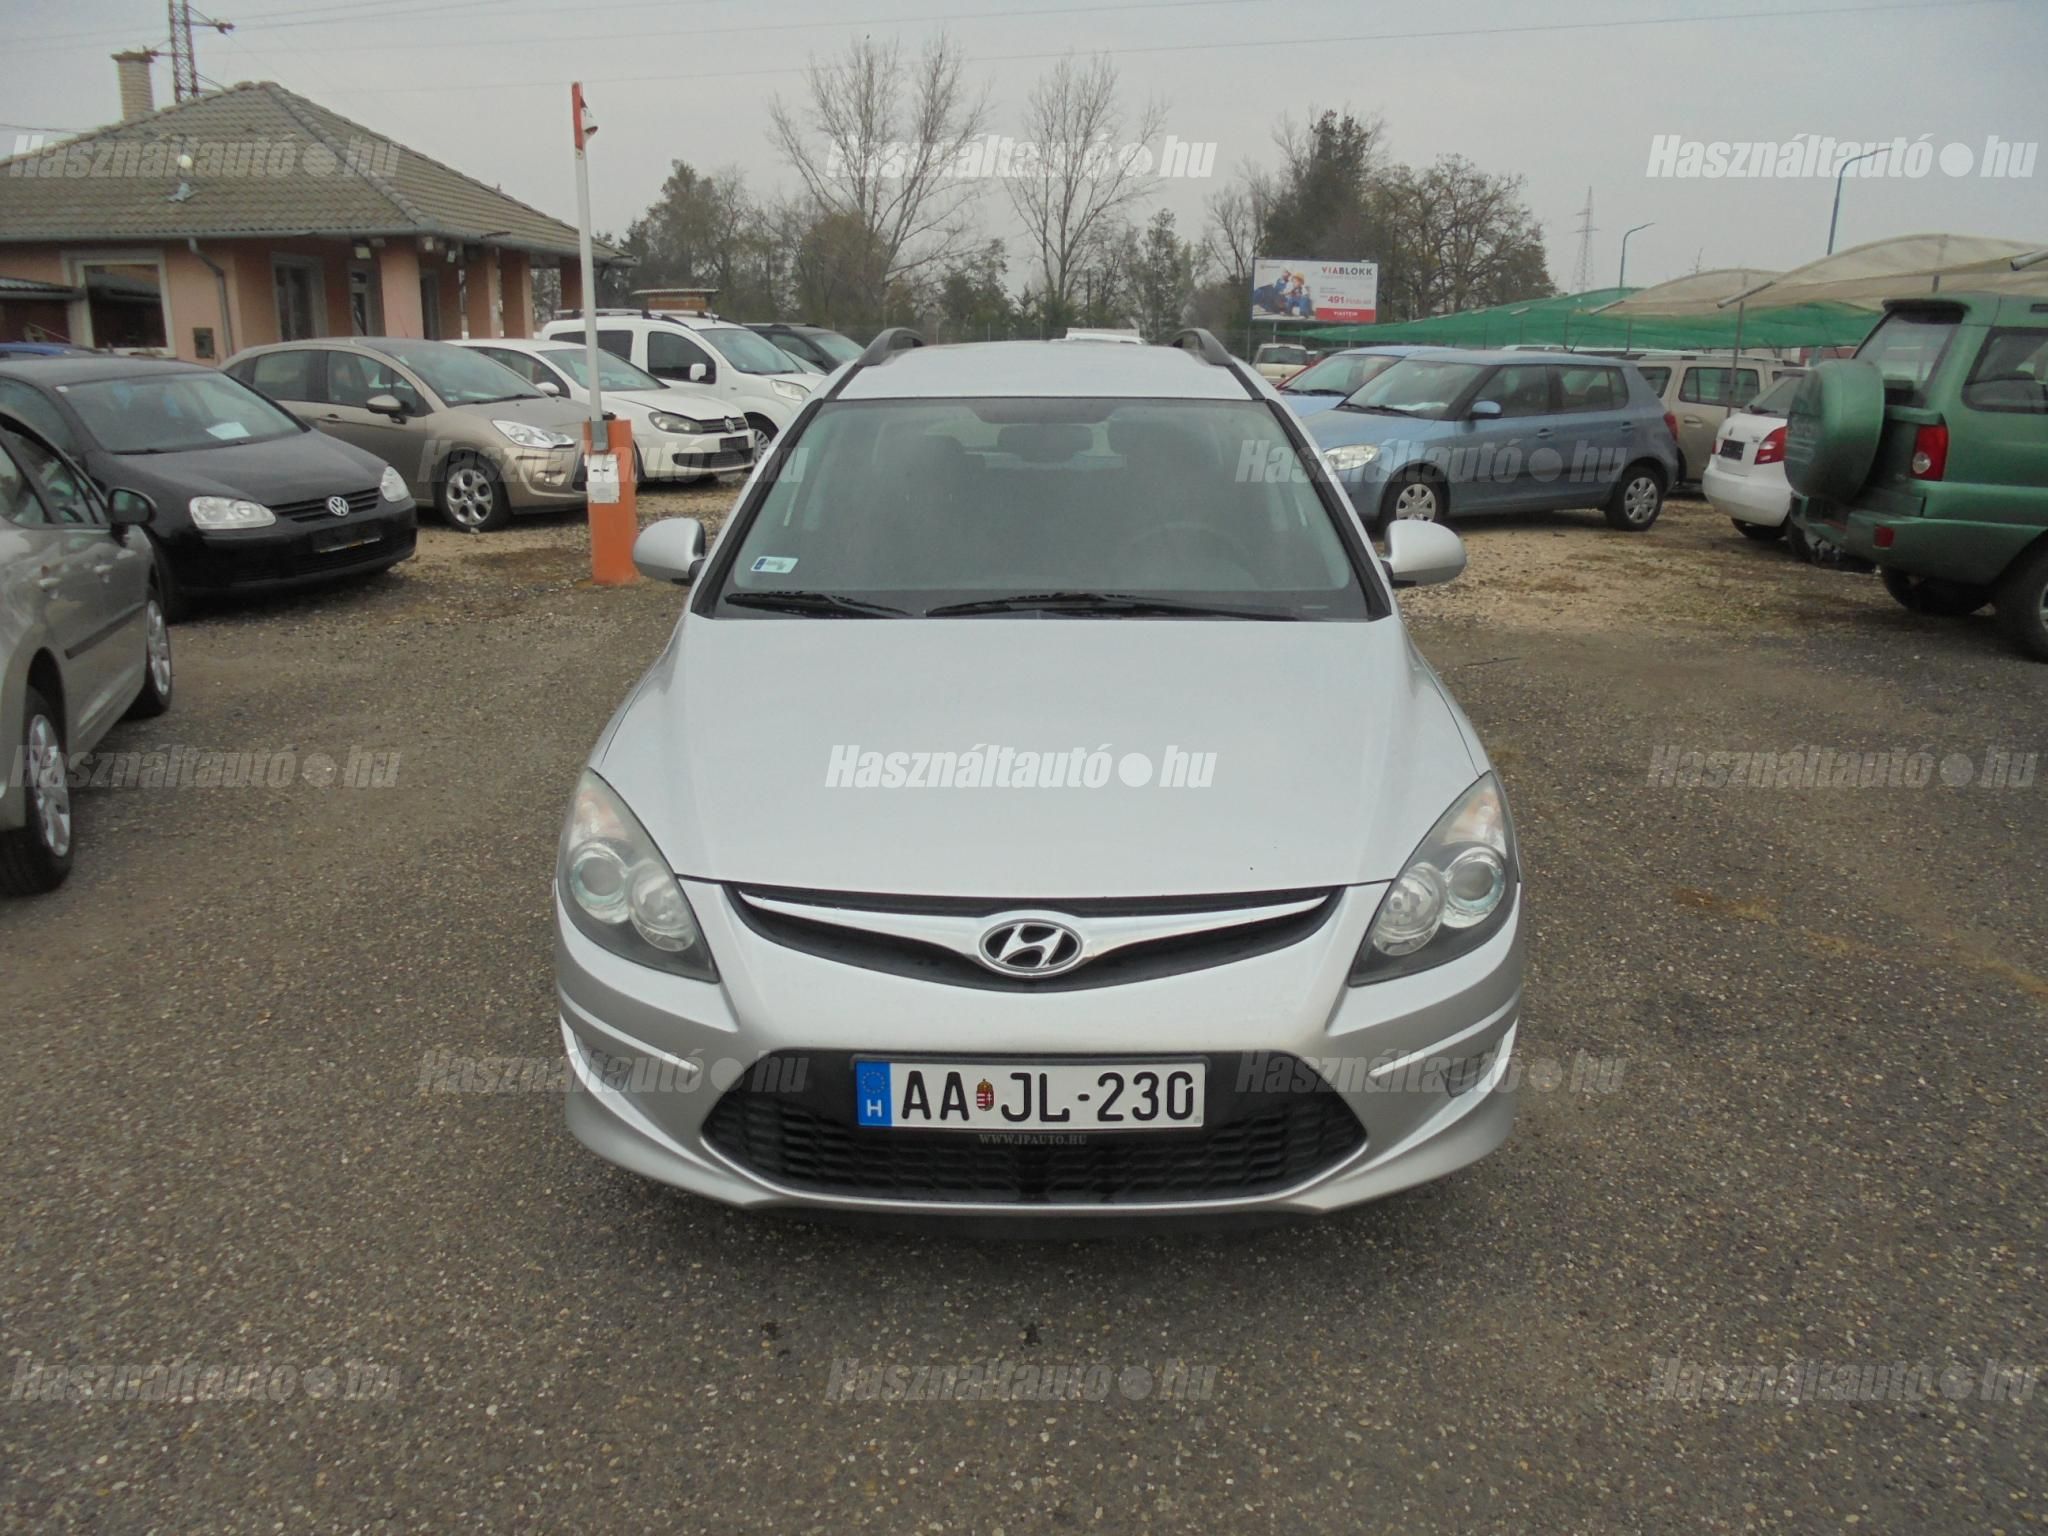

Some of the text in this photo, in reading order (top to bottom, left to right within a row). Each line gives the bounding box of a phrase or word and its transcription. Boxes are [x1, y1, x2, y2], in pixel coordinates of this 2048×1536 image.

[1321, 266, 1373, 275] VIABLOKK
[901, 1070, 1194, 1122] AA JL-230
[867, 1099, 882, 1118] H
